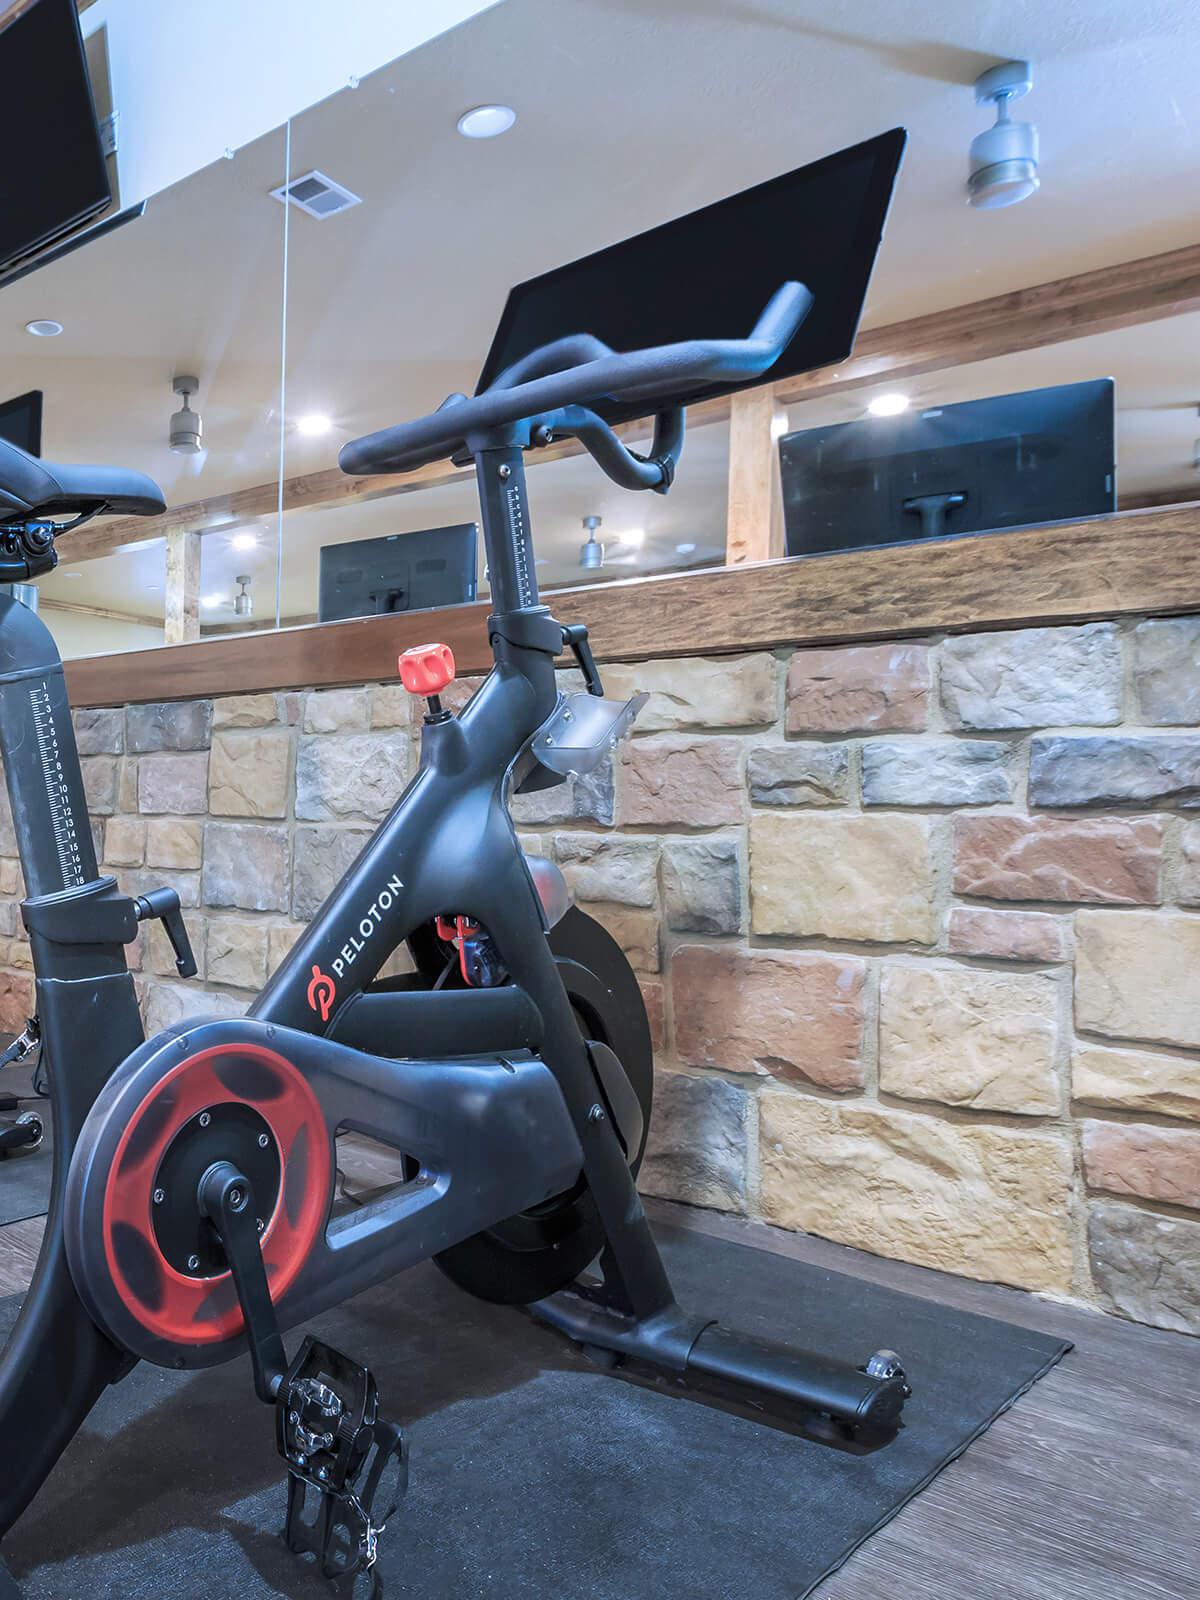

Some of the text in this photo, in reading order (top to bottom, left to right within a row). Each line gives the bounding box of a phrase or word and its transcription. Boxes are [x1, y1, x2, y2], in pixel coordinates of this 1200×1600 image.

[46, 704, 51, 713] 3
[52, 739, 57, 747] 6
[59, 785, 67, 793] 10
[61, 796, 68, 804] 11
[63, 807, 71, 815] 12
[65, 819, 73, 827] 13
[67, 830, 76, 838] 14
[70, 843, 78, 851] 15
[72, 854, 80, 863] 16
[74, 865, 82, 874] 17
[76, 876, 84, 885] 18
[331, 874, 405, 979] PELOTON
